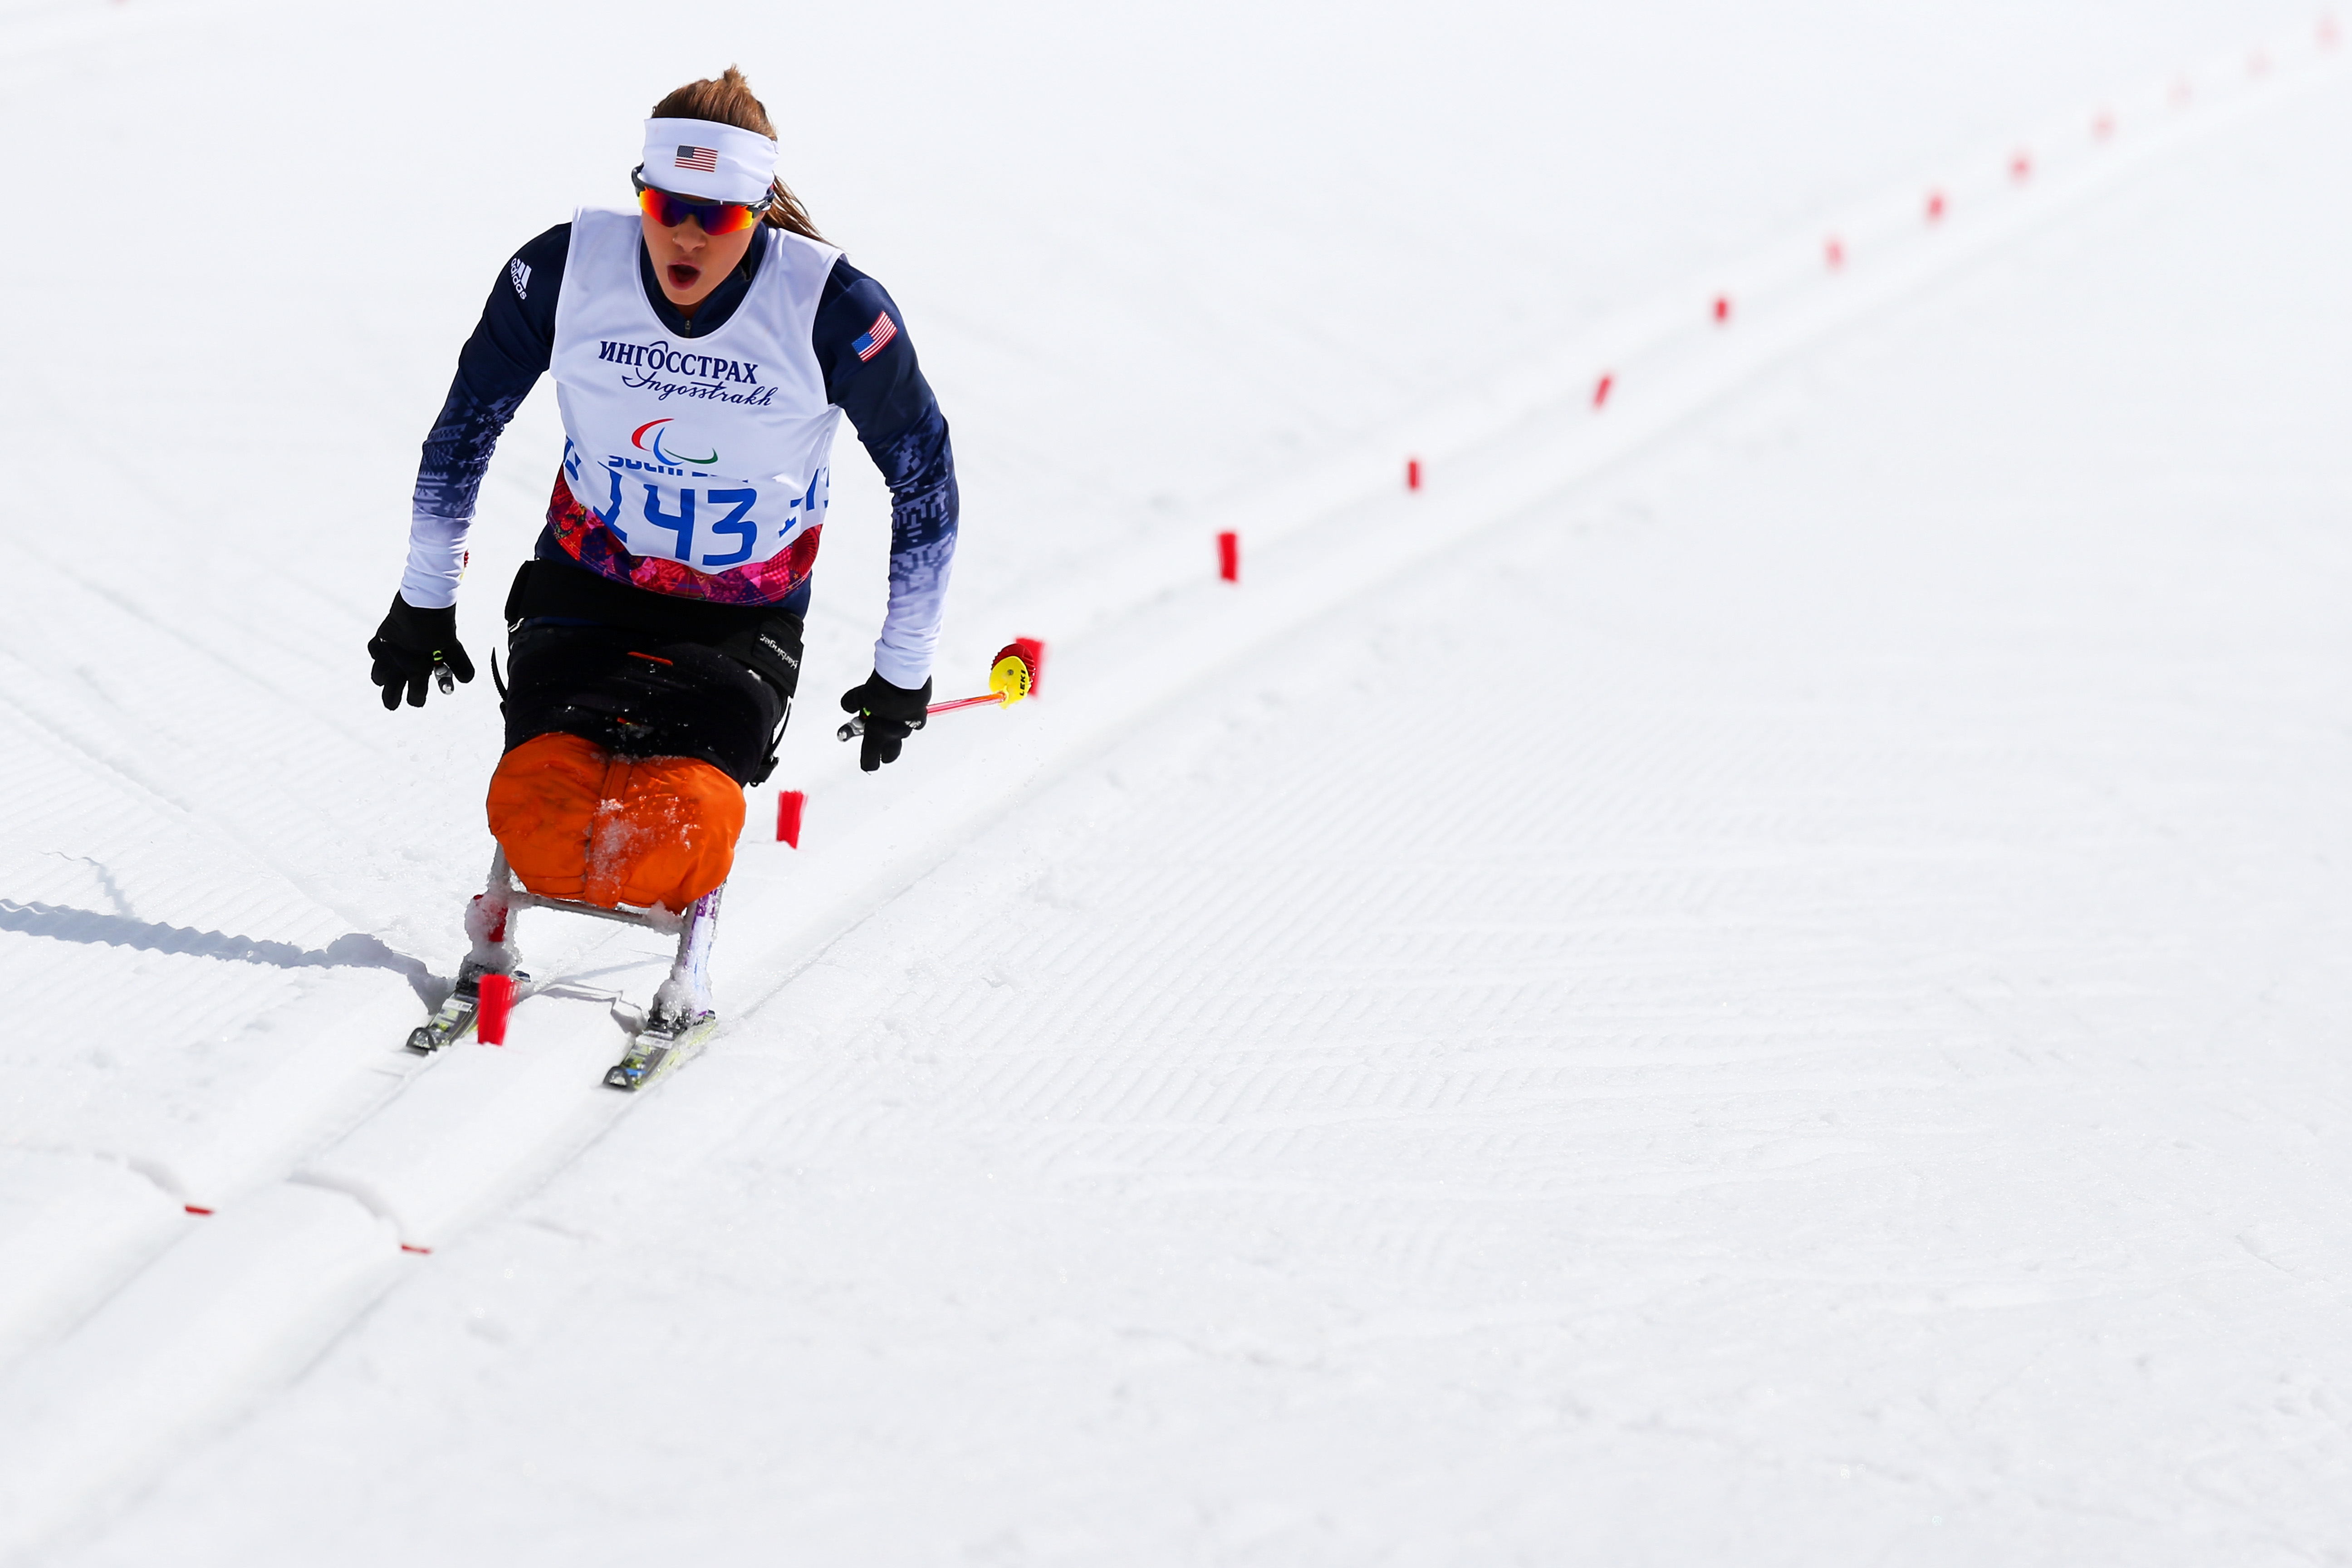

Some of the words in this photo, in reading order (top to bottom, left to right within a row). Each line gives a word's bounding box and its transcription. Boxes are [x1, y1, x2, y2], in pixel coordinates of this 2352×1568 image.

[511, 258, 527, 300] adidas
[598, 341, 758, 384] ИНГОССТРАХ
[622, 368, 778, 406] Ingosstrakh
[593, 461, 757, 566] 143
